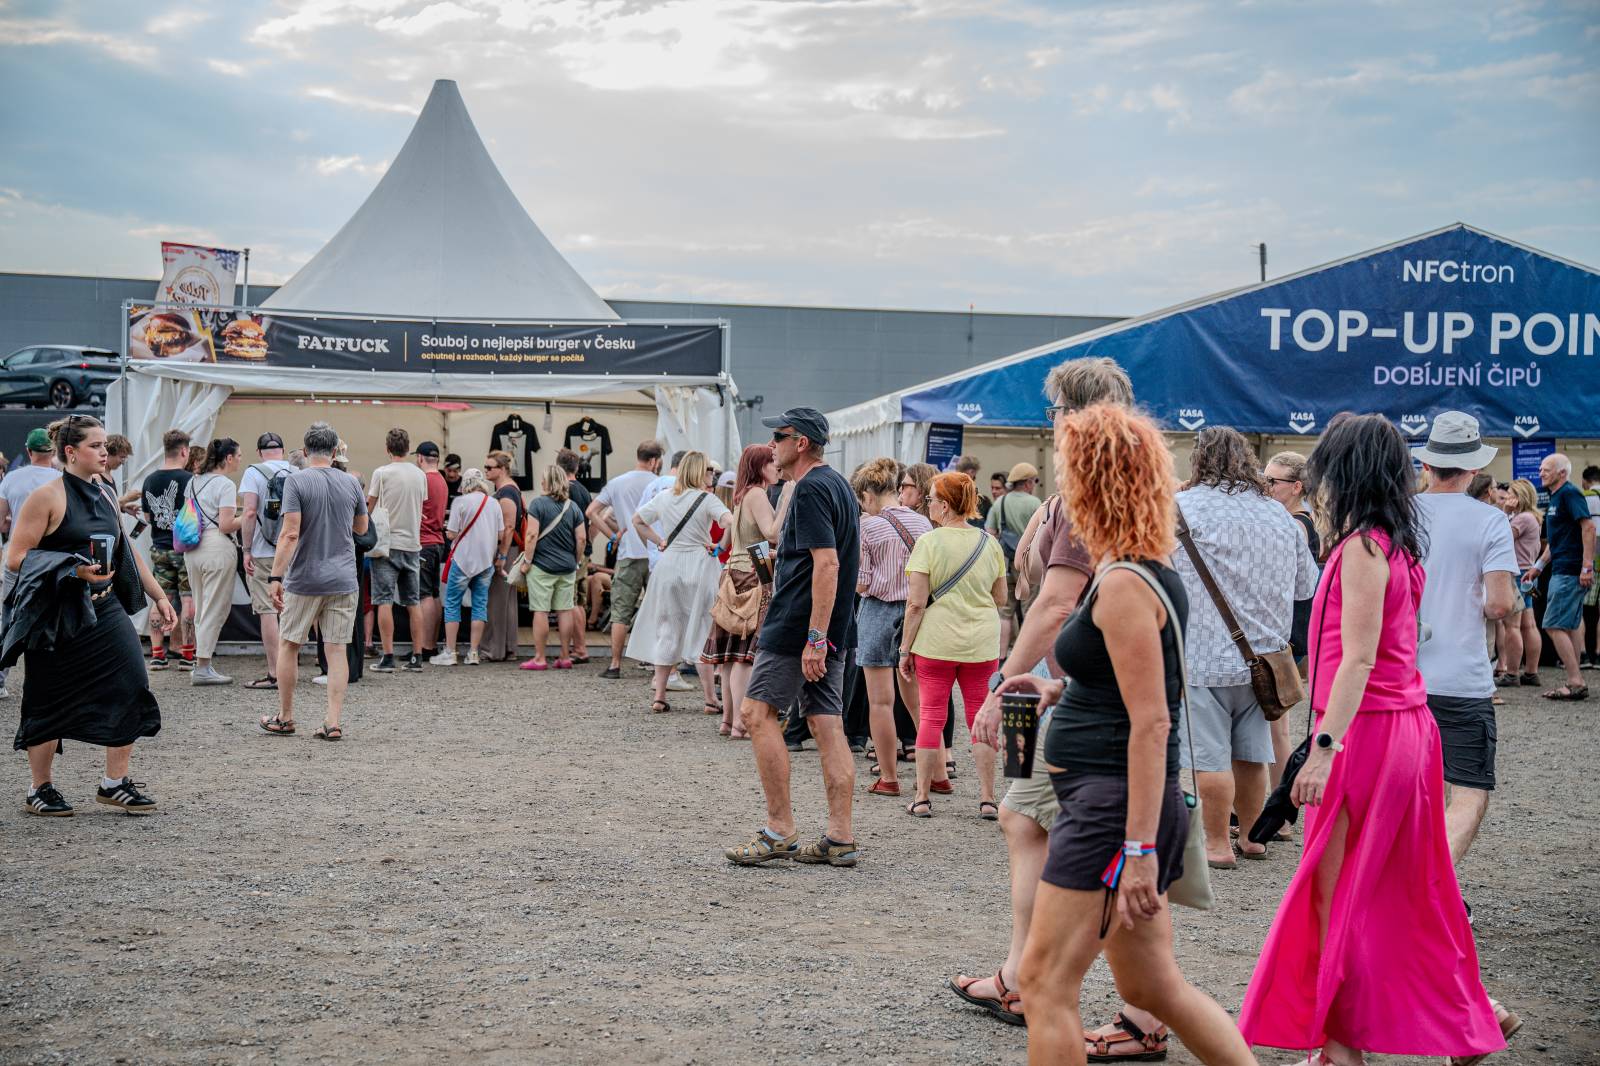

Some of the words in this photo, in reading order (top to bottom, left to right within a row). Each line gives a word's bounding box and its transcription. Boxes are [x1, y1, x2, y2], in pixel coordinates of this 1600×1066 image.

[1403, 260, 1514, 284] NFCtron
[1261, 308, 1475, 354] TOP-UP
[297, 335, 390, 353] FATFUCK
[421, 334, 467, 351] Souboj
[470, 338, 479, 348] o
[482, 336, 534, 351] nejlepší
[536, 336, 580, 352] burger
[583, 340, 591, 349] v
[594, 334, 635, 350] Česku
[421, 352, 455, 362] ochutnej
[499, 354, 522, 363] každý
[523, 354, 549, 363] burger
[1374, 361, 1481, 386] DOBÍJENÍ
[1487, 361, 1541, 387] ČIPŮ
[957, 403, 981, 411] KASA
[1180, 409, 1203, 417] KASA
[1290, 412, 1315, 421] KASA
[1401, 415, 1426, 423] KASA
[1515, 416, 1539, 425] KASA
